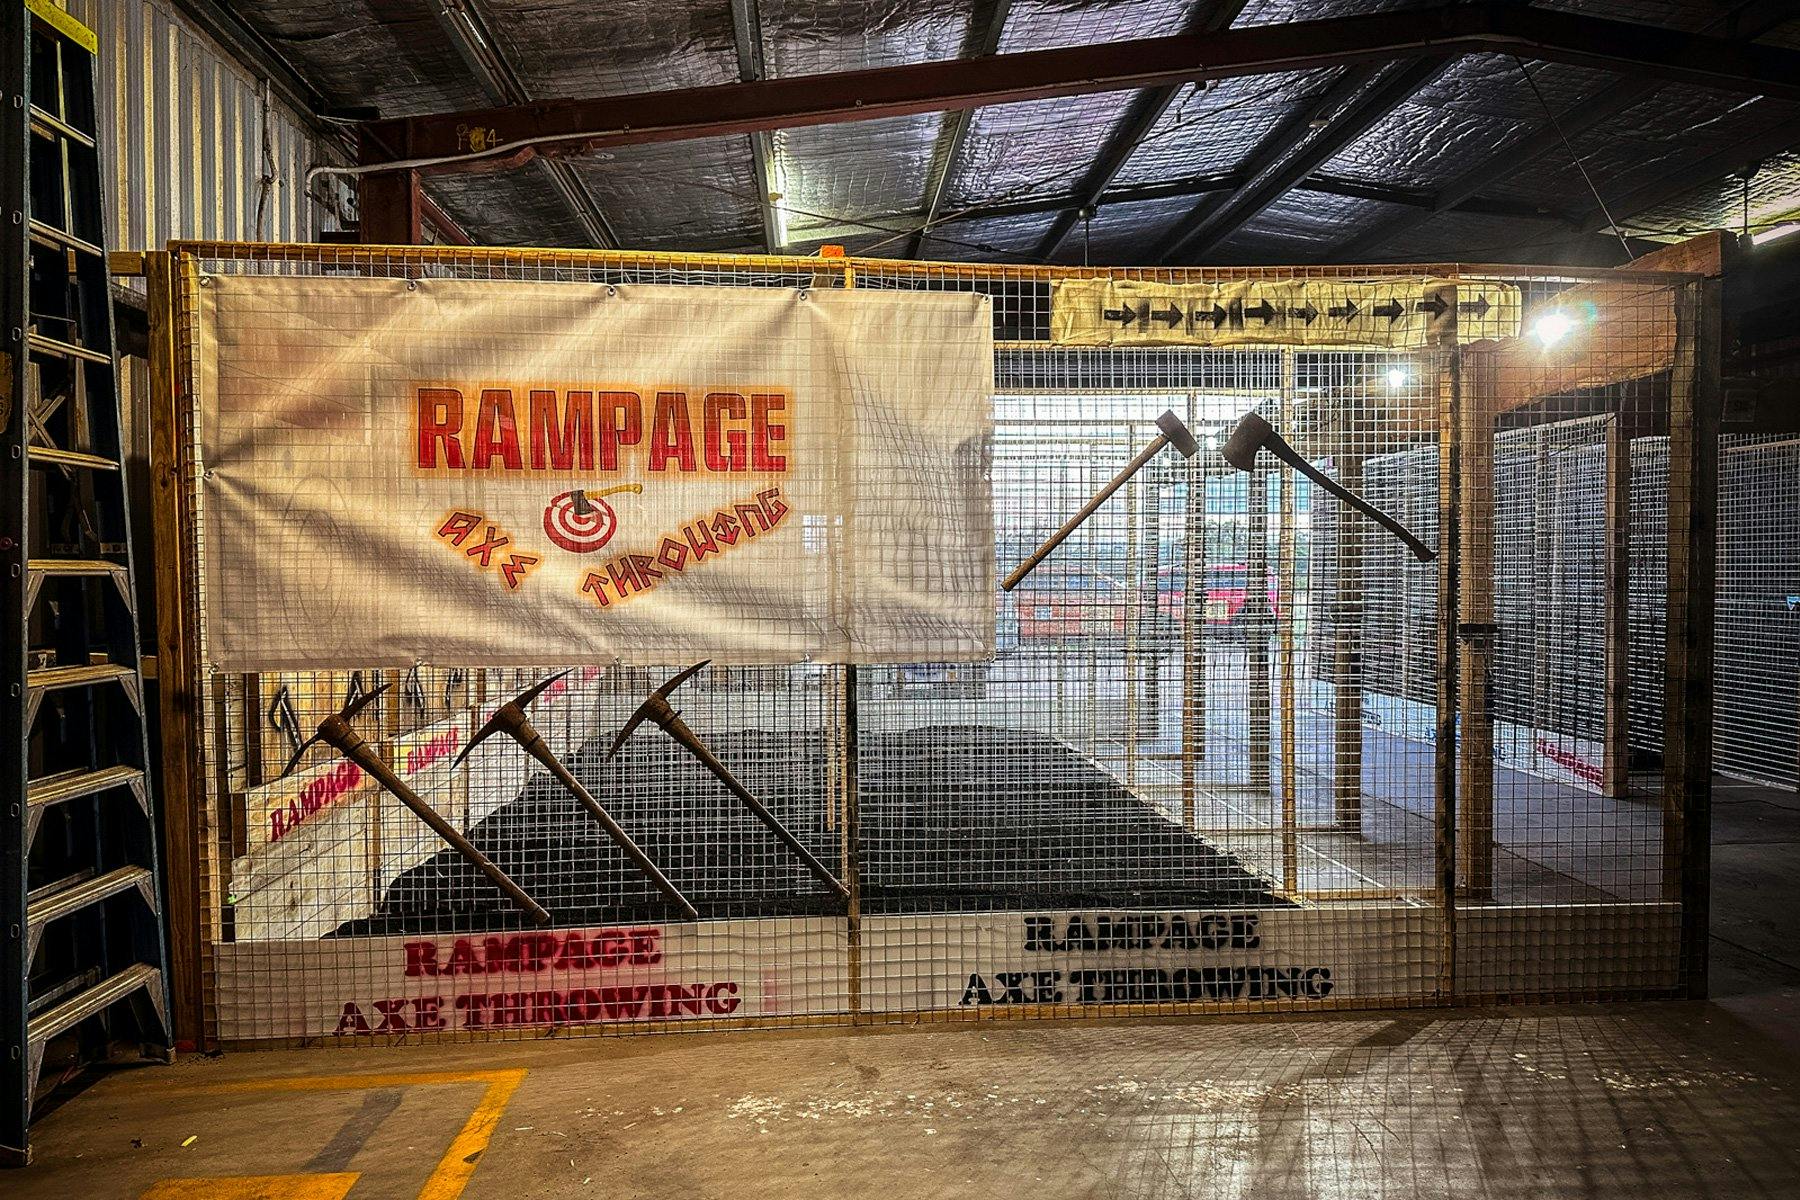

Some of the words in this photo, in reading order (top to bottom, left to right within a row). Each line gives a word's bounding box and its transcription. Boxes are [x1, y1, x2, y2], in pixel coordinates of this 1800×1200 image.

[418, 388, 786, 472] RAMPAGE
[438, 511, 539, 589] AXE
[582, 487, 790, 607] THROWING
[404, 928, 661, 977] RAMPAGE
[1023, 914, 1261, 951] RAMPAGE
[332, 996, 447, 1037] AXE
[455, 982, 742, 1031] THROWING
[958, 969, 1064, 1006] AXE
[1069, 966, 1335, 1003] THROWING
